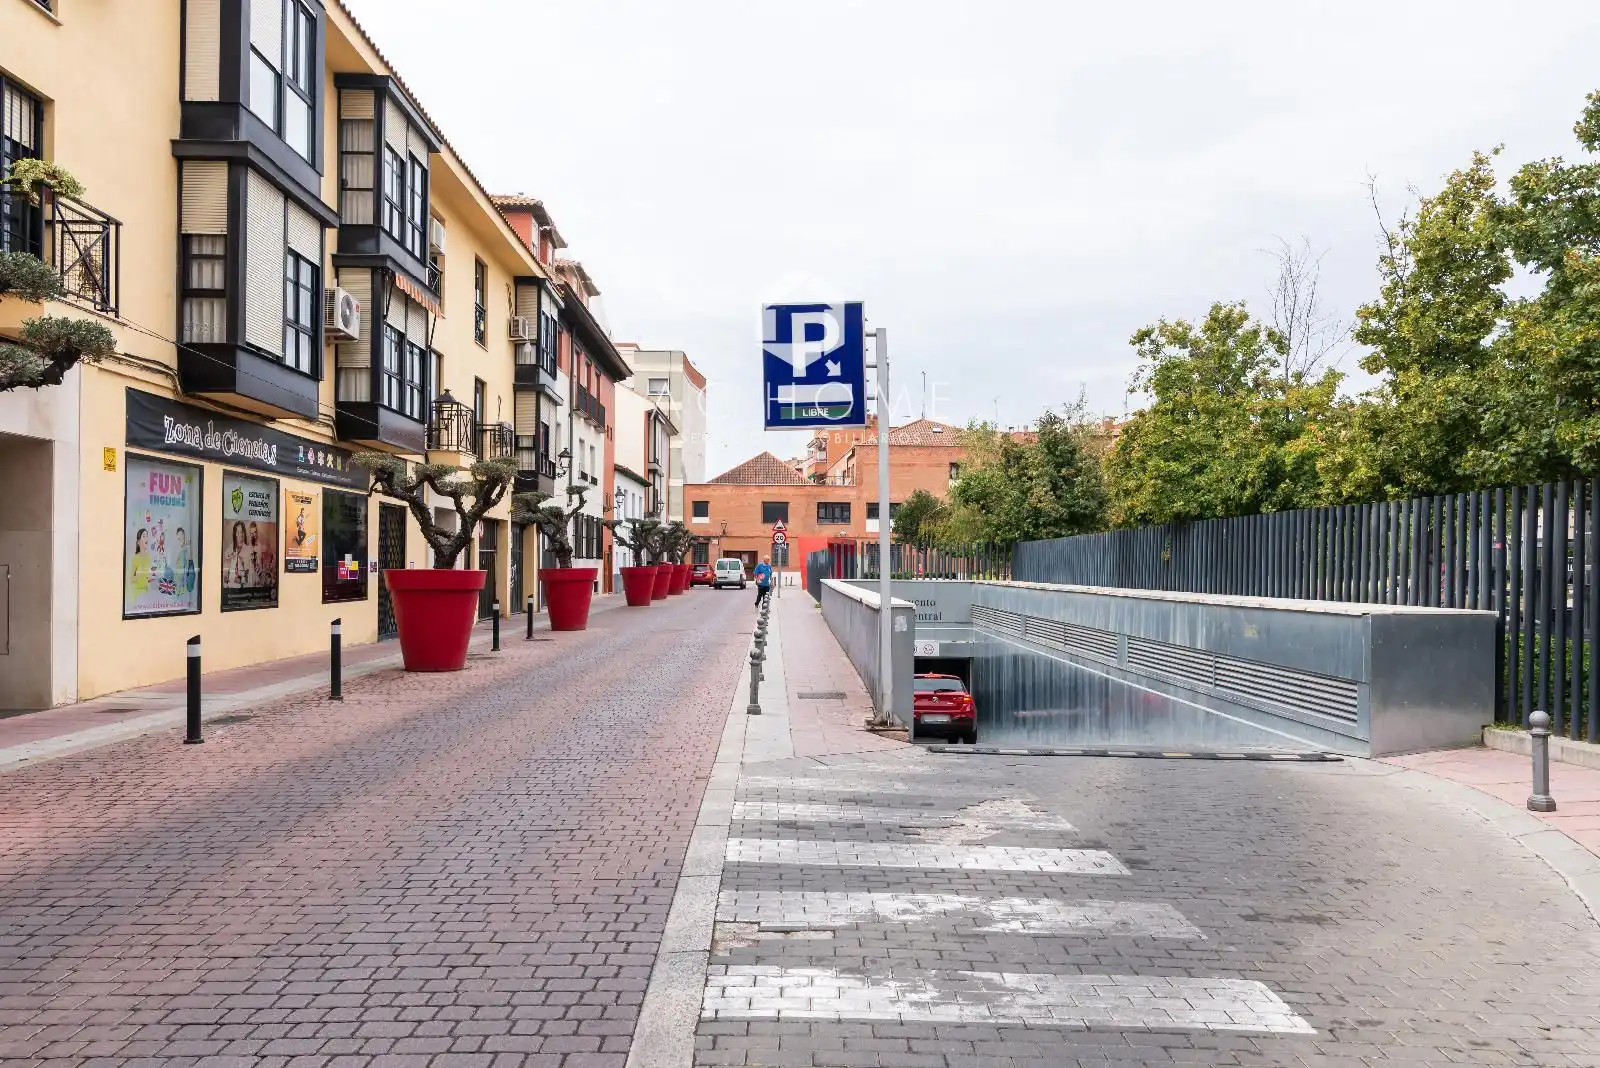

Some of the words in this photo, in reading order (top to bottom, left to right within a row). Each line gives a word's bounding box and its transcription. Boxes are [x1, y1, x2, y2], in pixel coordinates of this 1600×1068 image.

[791, 312, 840, 377] P
[802, 408, 829, 417] LIBRE
[164, 415, 203, 450] Zona
[204, 419, 222, 449] de
[222, 428, 277, 466] Ciencias
[149, 471, 182, 495] FUN
